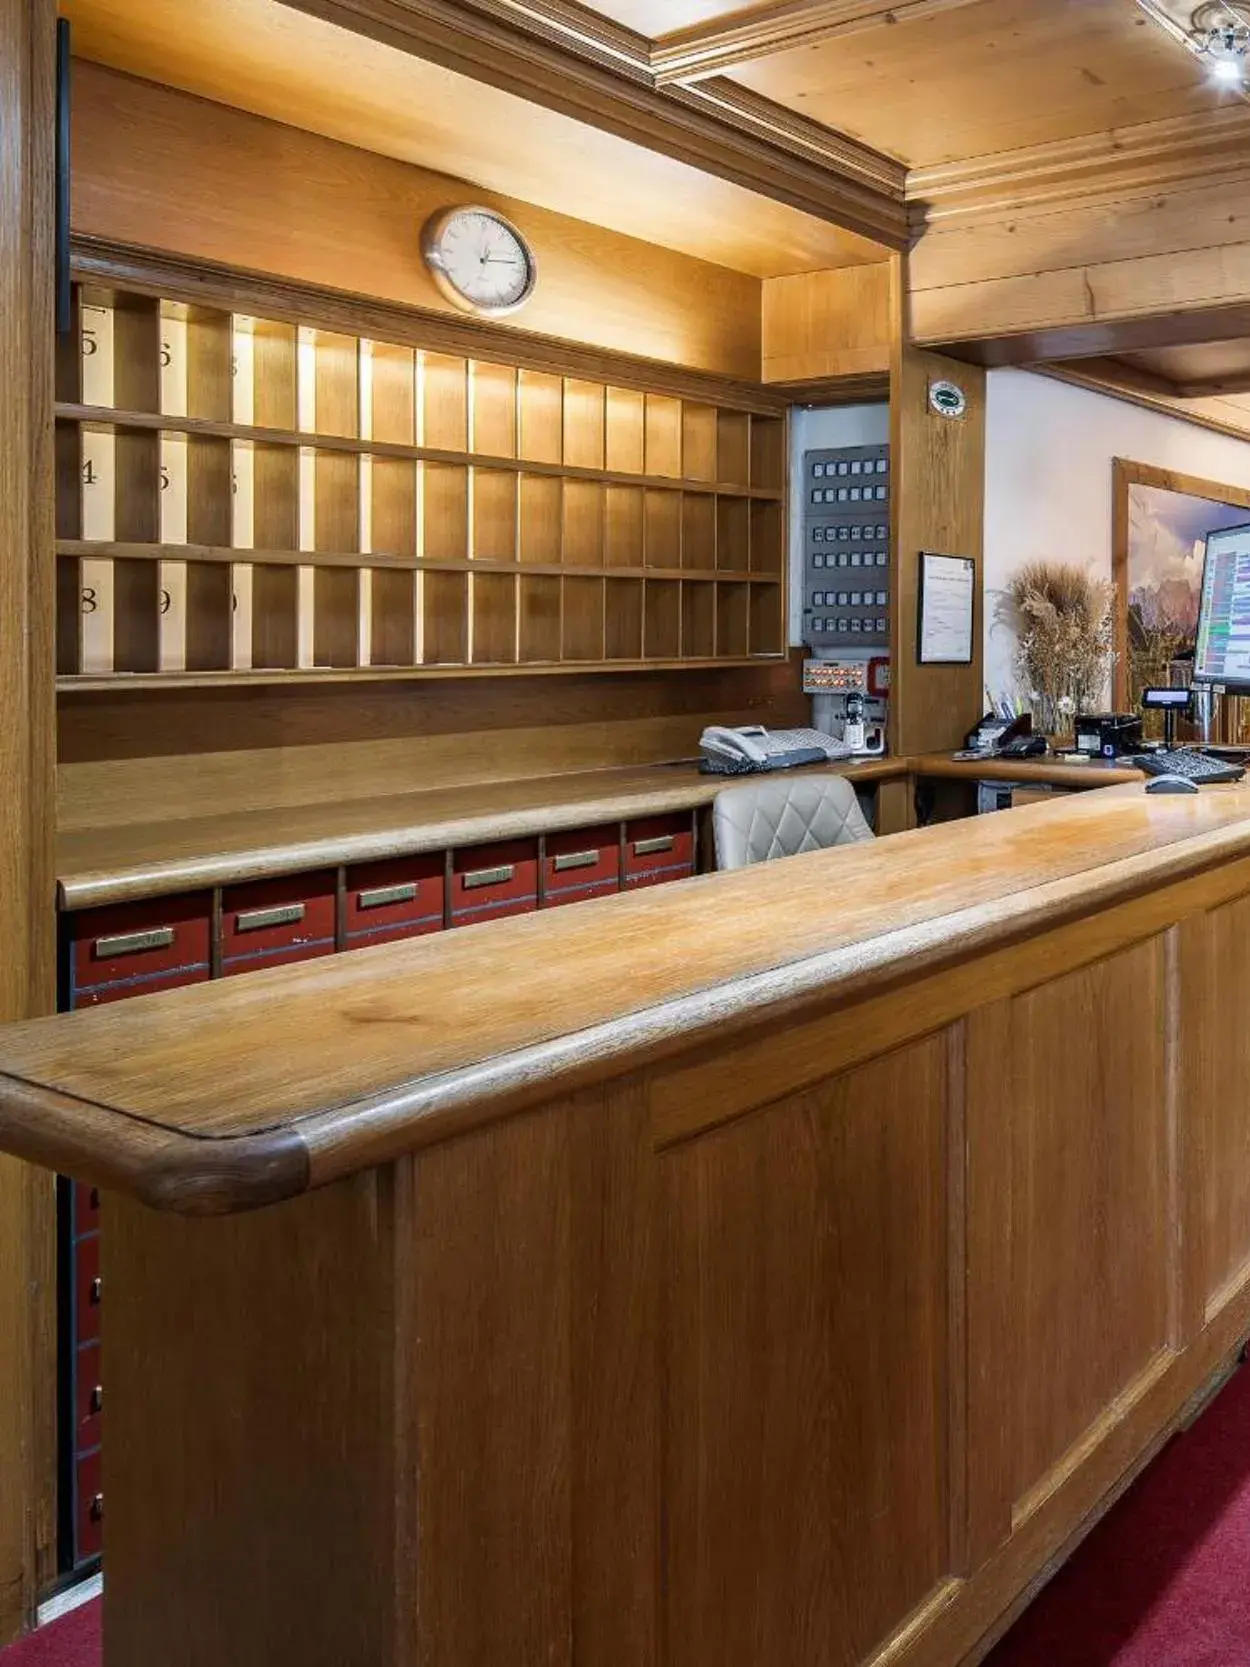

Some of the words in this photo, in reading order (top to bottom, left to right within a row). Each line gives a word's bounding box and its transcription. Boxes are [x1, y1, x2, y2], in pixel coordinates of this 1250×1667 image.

[81, 330, 97, 356] 5
[159, 342, 171, 368] 6
[81, 459, 97, 485] 4
[81, 587, 97, 615] 8
